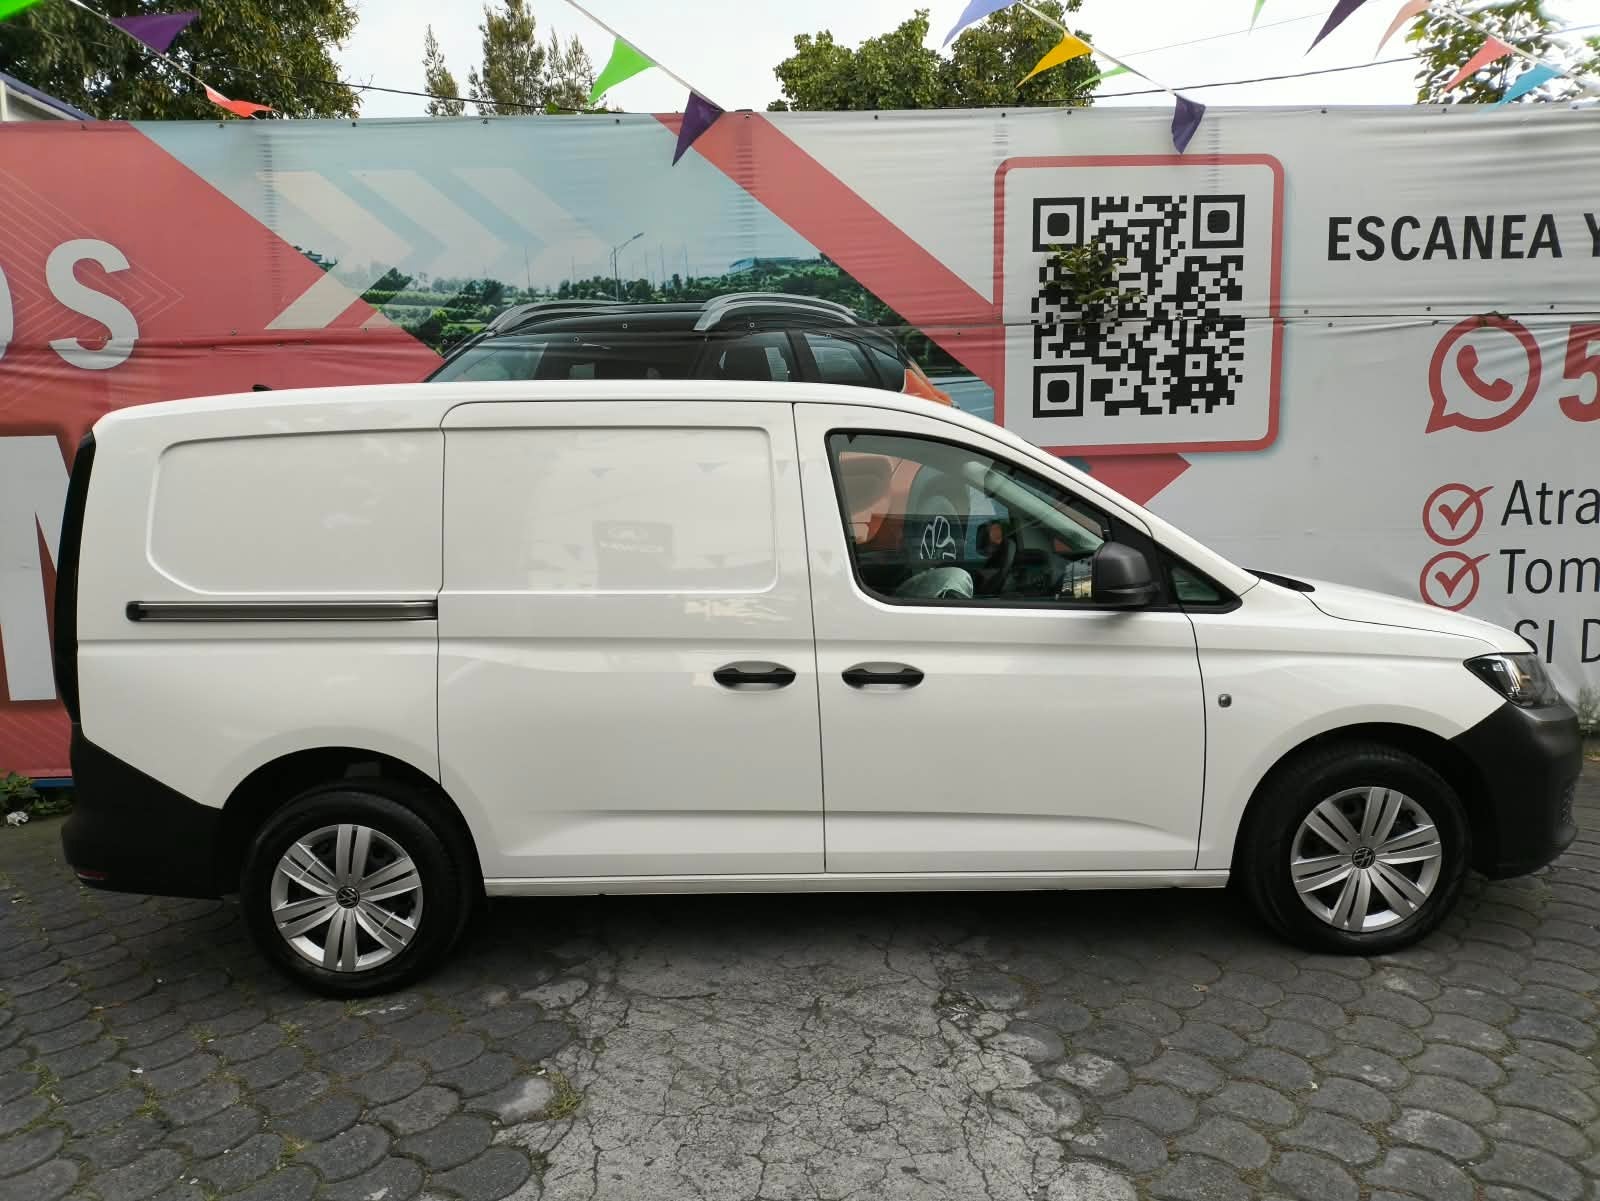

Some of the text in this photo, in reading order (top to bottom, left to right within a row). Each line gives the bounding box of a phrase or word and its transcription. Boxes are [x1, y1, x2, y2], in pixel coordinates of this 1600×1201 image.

[1328, 214, 1563, 261] ESCANEA
[0, 238, 139, 369] S
[1558, 323, 1600, 422] 5
[1501, 480, 1600, 526] Atra
[1500, 549, 1600, 594] Tom
[1514, 619, 1555, 664] SI
